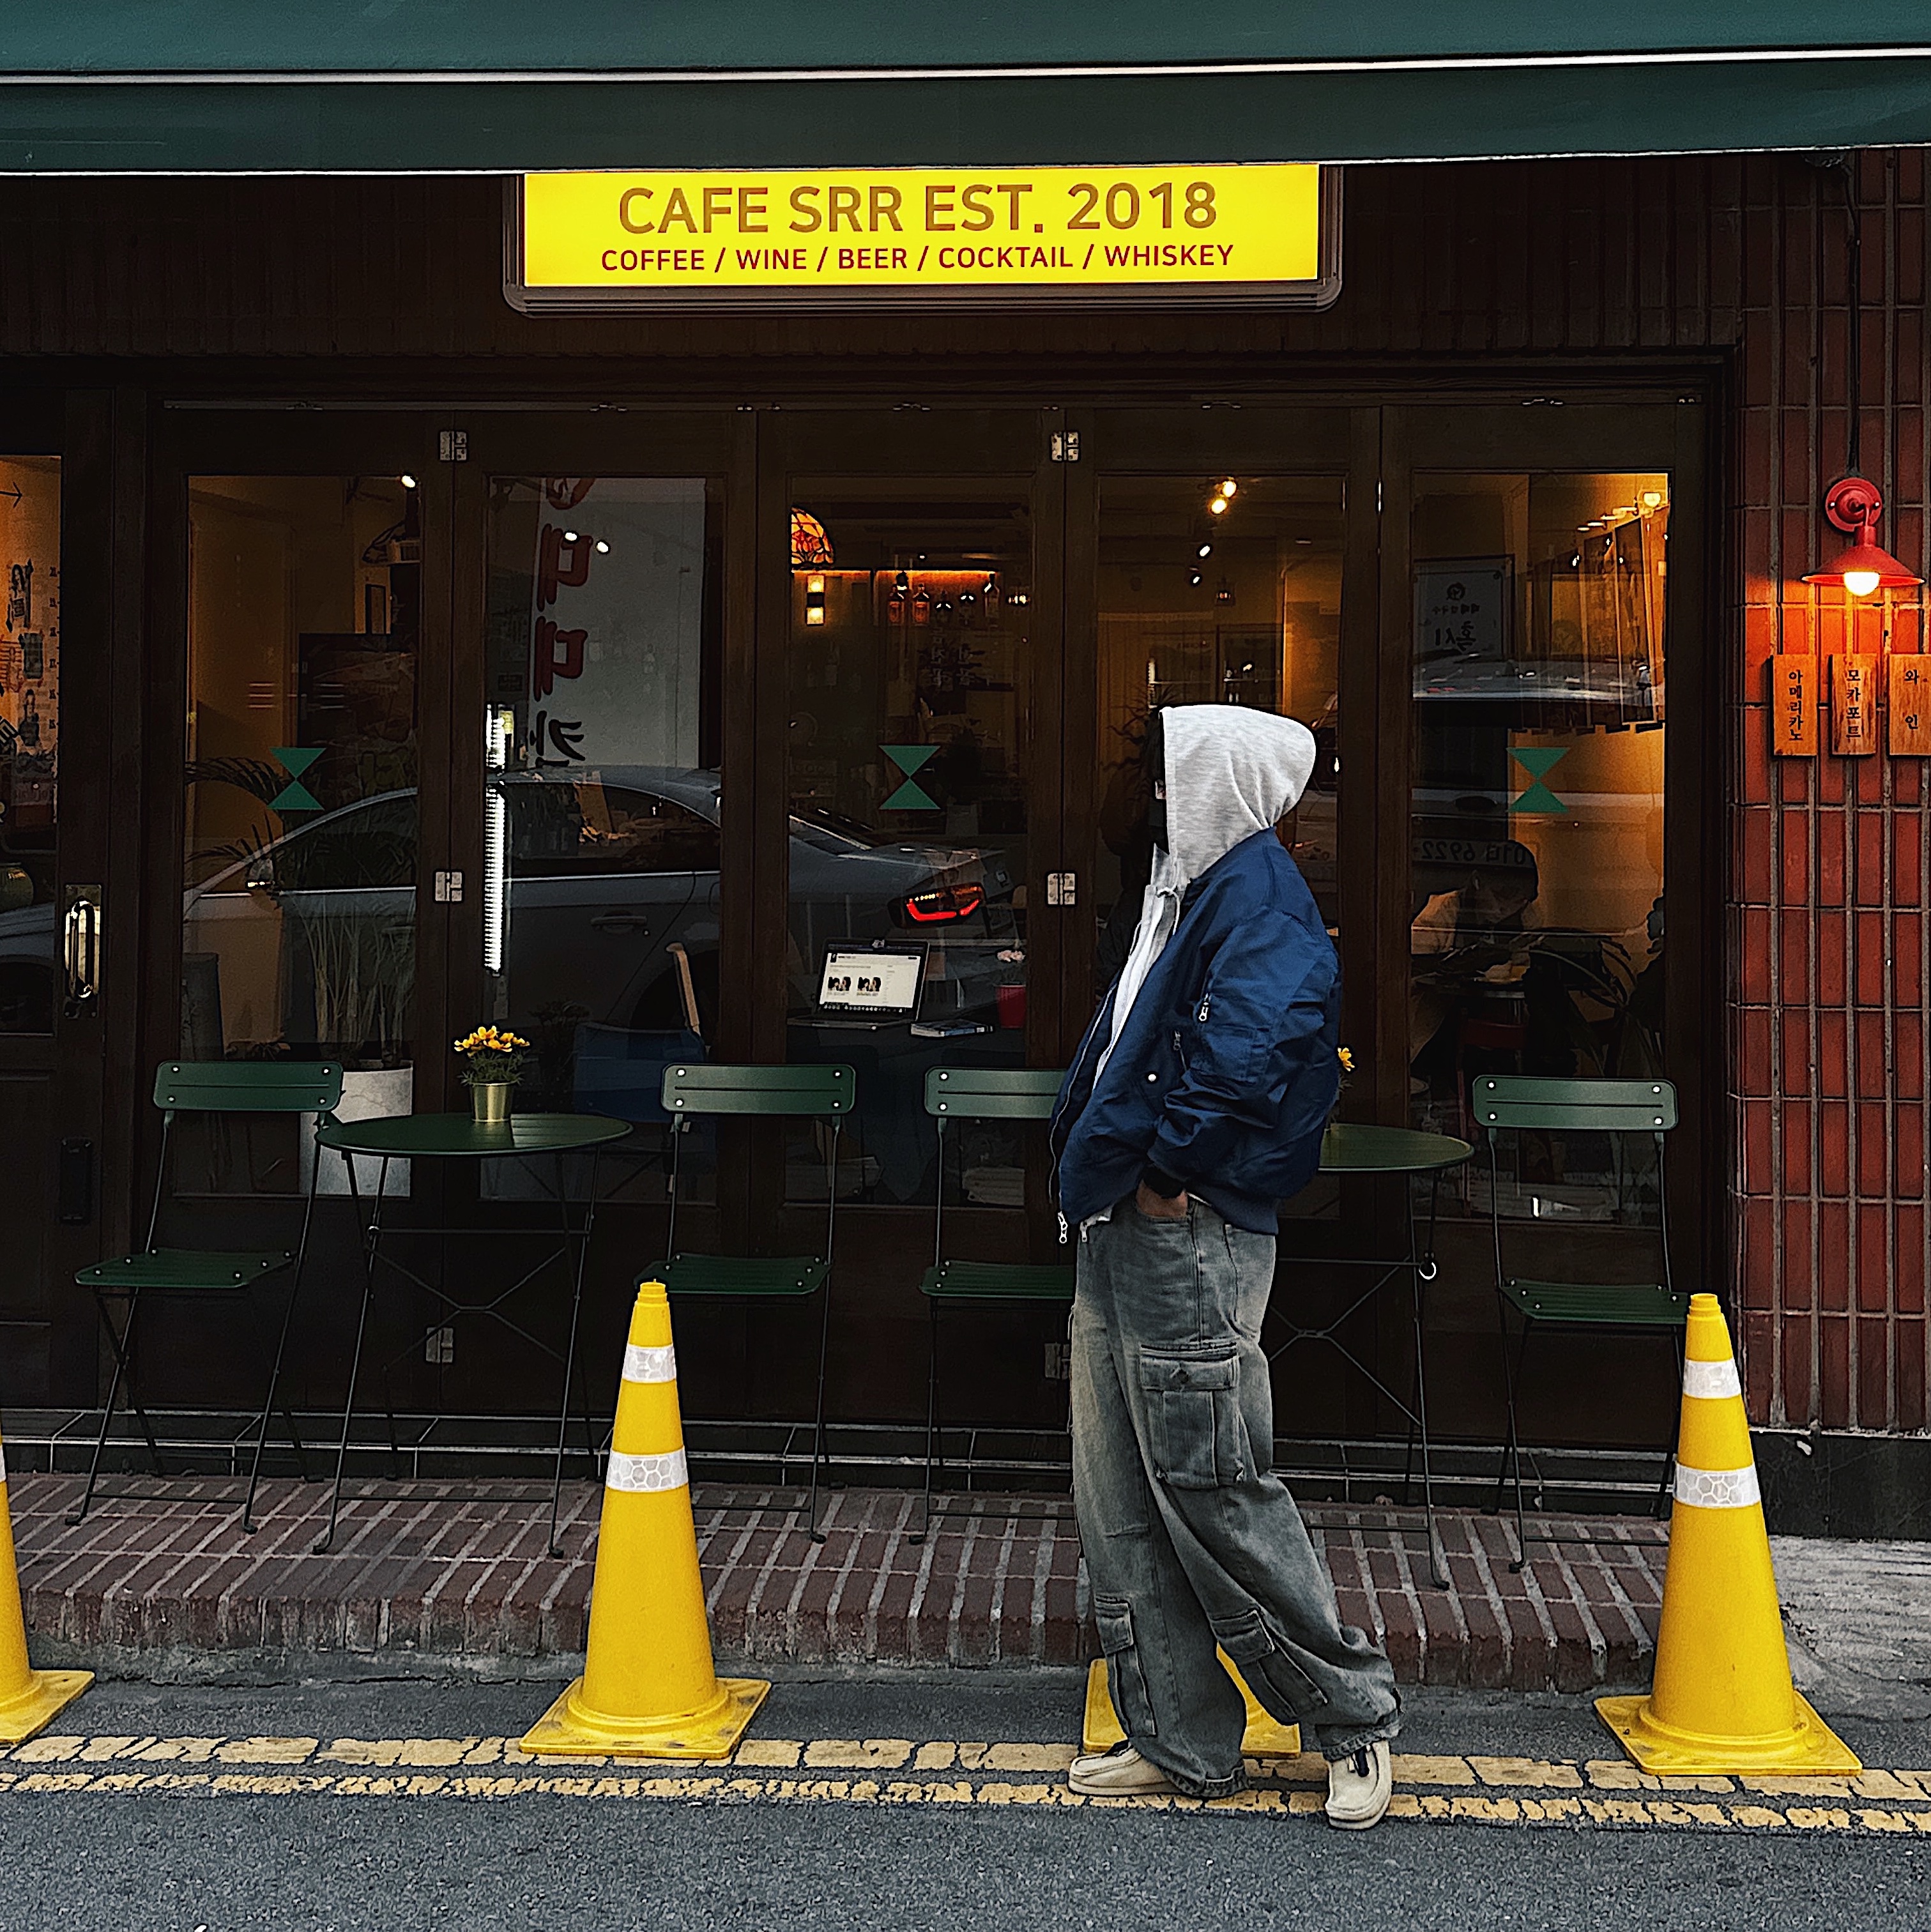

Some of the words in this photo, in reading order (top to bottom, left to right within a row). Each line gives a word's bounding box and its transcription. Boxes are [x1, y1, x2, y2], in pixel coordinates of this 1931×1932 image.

[619, 186, 768, 234] CAFE
[788, 185, 904, 233] SRR
[925, 184, 1044, 234] EST.
[1067, 181, 1217, 230] 2018
[601, 249, 705, 271] COFFEE
[735, 248, 807, 270] WINE
[839, 247, 908, 270] BEER
[938, 246, 1074, 269] COCKTAIL
[1103, 244, 1234, 267] WHISKEY
[1789, 669, 1804, 742] 아메리카노
[1846, 669, 1861, 738] 모카포트
